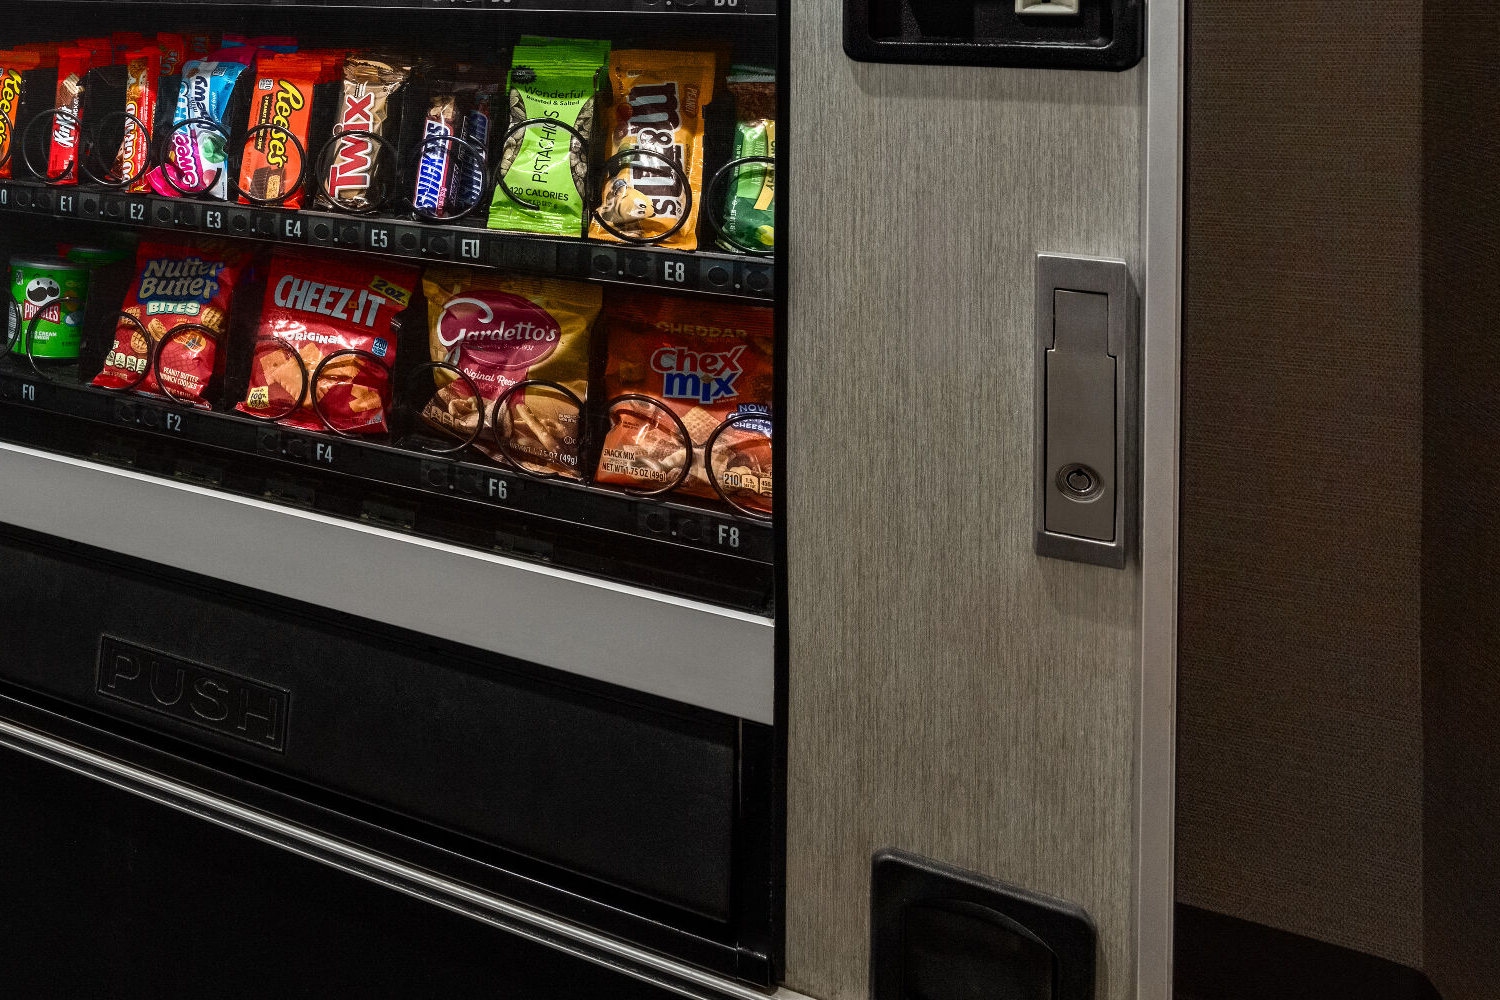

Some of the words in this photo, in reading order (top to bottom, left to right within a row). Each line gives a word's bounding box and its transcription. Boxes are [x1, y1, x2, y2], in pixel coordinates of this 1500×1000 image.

[524, 86, 585, 100] Wonderful
[526, 95, 551, 106] Roasted
[686, 86, 698, 115] PEANUT
[268, 78, 304, 168] Reese's
[329, 93, 374, 199] TWIX
[510, 187, 524, 195] 120
[525, 188, 569, 201] CALORIES
[60, 196, 73, 212] E1
[130, 205, 144, 220] E2
[207, 212, 221, 228] E3
[285, 220, 301, 237] E4
[371, 230, 388, 247] E5
[147, 259, 225, 278] Nutter
[664, 262, 685, 282] E8
[139, 277, 220, 300] Butter
[372, 279, 385, 291] 2
[148, 302, 199, 315] BITES
[437, 297, 557, 360] Gardetto's
[656, 321, 748, 339] CHEDDAR
[652, 345, 745, 373] Chex
[163, 367, 180, 378] PEANUT
[180, 372, 199, 383] BUTTER
[177, 378, 198, 389] COOKIES
[463, 368, 495, 382] Original
[664, 372, 737, 402] mix
[739, 404, 768, 413] NOW
[167, 414, 181, 431] F2
[317, 444, 332, 462] F4
[560, 453, 578, 465] (49g)
[604, 449, 623, 460] SNACK
[623, 452, 635, 461] MIX
[602, 463, 614, 471] NET
[626, 466, 639, 476] 1.75
[639, 469, 649, 478] OZ
[650, 470, 667, 482] (49g)
[724, 474, 739, 486] 210
[489, 478, 507, 499] F6
[718, 525, 740, 548] F8
[108, 649, 277, 740] PUSH
